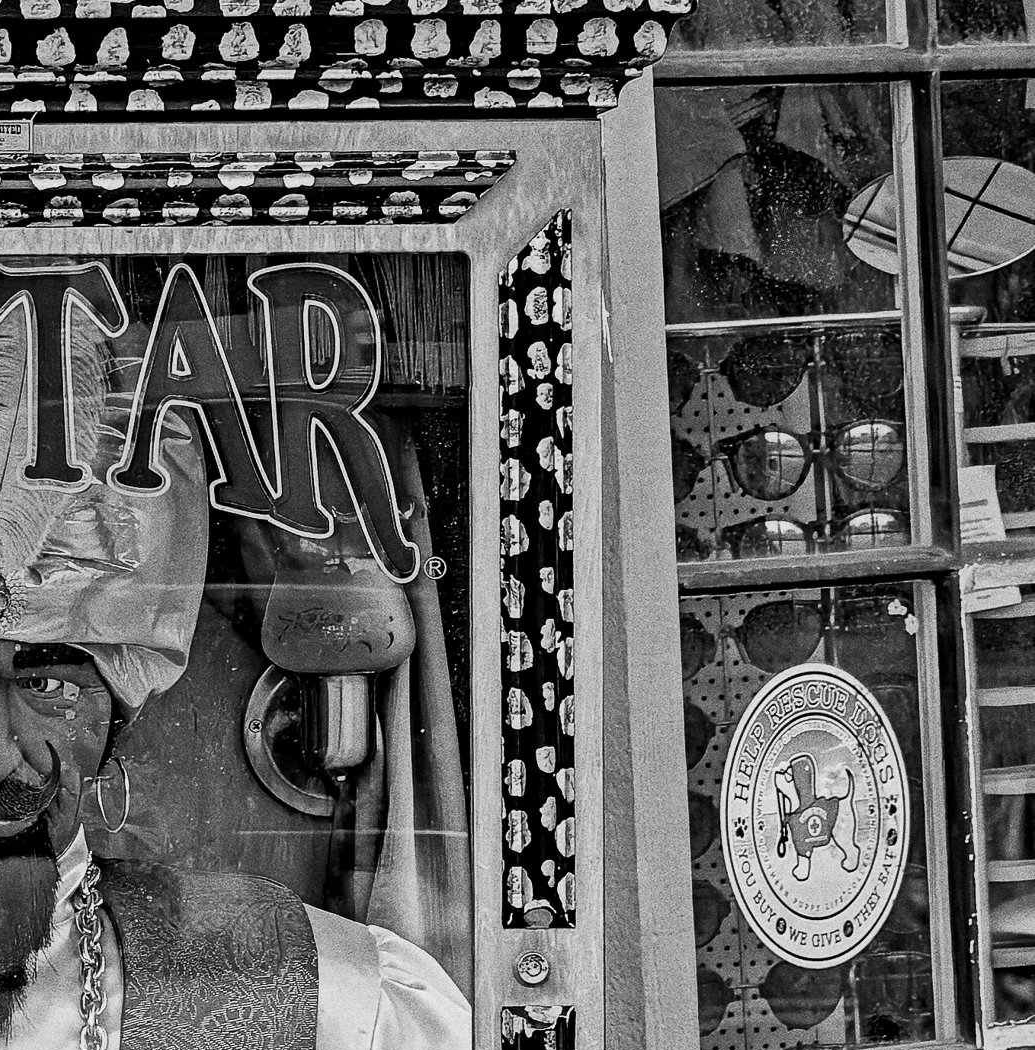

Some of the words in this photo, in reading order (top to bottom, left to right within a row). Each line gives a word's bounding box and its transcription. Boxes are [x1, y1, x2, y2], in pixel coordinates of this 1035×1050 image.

[733, 722, 766, 804] HELP
[767, 683, 850, 728] RESCUE
[736, 849, 757, 887] YOU
[753, 889, 777, 923] BUY
[788, 925, 808, 947] WE
[811, 929, 843, 948] GIVE
[853, 884, 882, 928] THEY
